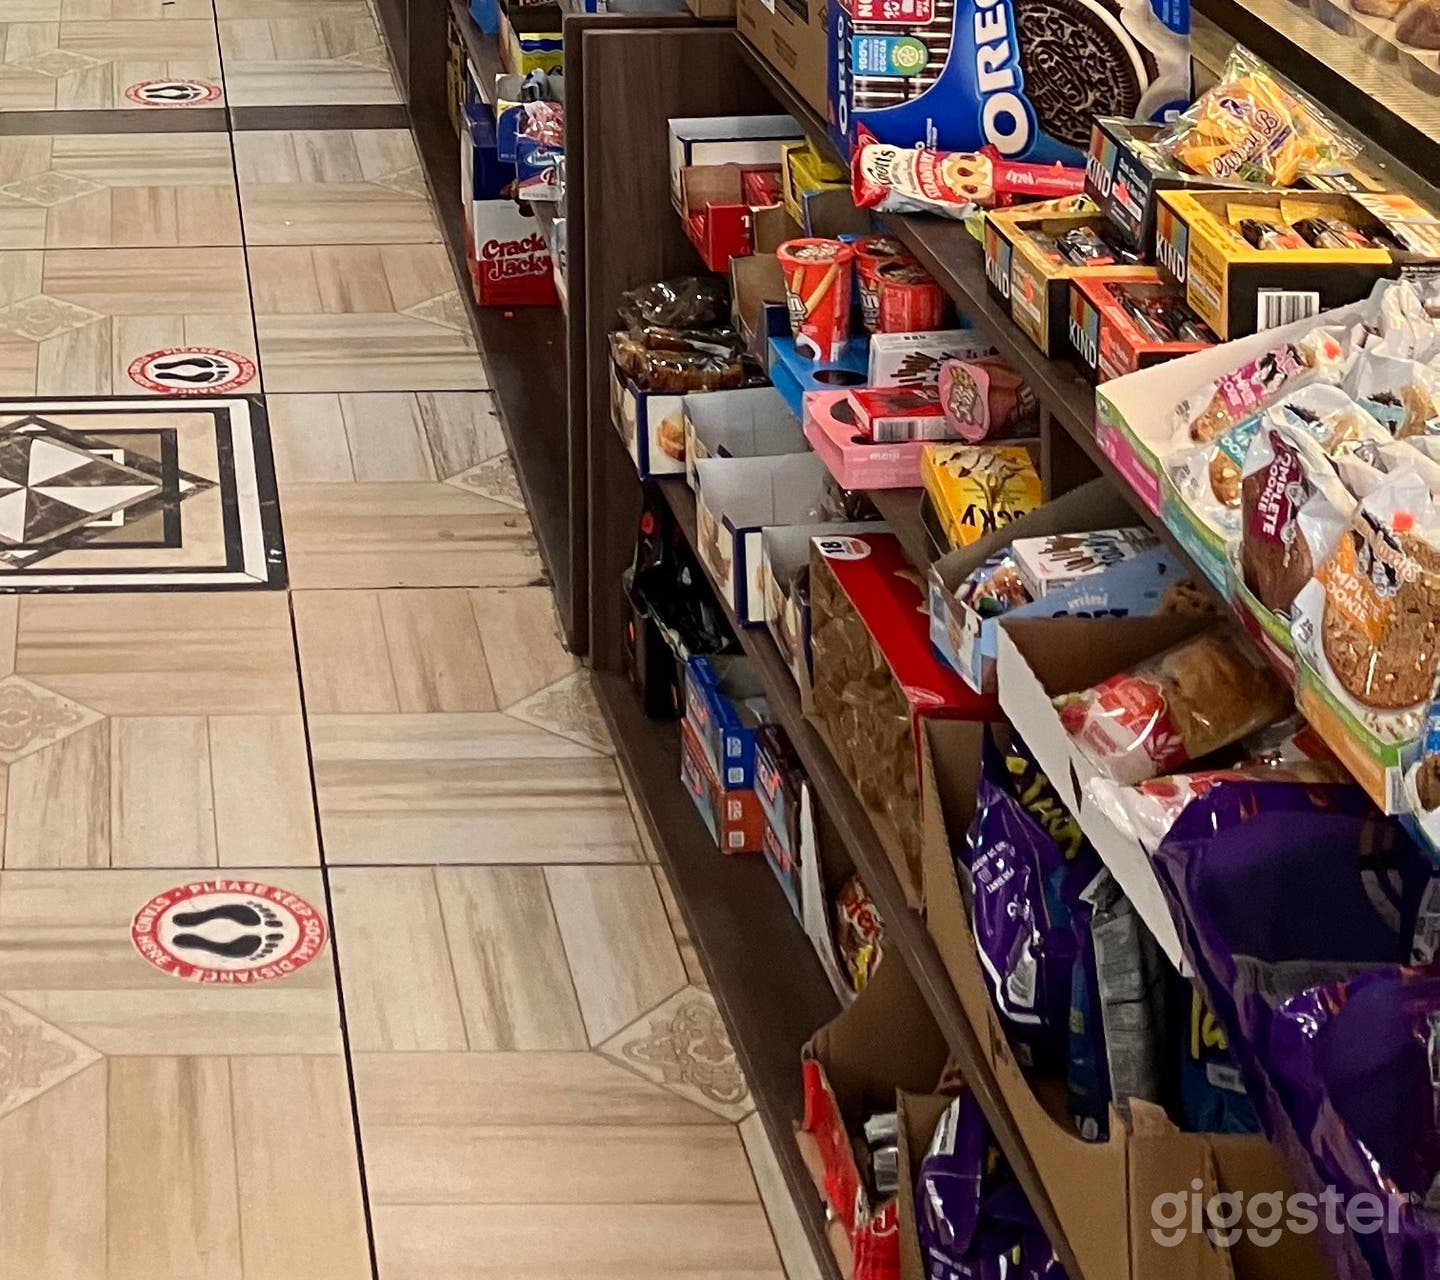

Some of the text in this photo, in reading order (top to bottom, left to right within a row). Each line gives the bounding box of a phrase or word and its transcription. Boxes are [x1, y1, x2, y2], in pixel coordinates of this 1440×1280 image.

[837, 16, 848, 137] OREO
[858, 39, 868, 71] 100%
[879, 39, 887, 72] COCOA
[1085, 153, 1114, 200] KIND
[985, 256, 1011, 301] KIND
[1154, 231, 1187, 285] KIND
[1069, 310, 1098, 370] KIND
[1263, 452, 1292, 536] OMPLETE
[189, 878, 322, 982] PLEASE KEEP SOCIAL DISTANCE
